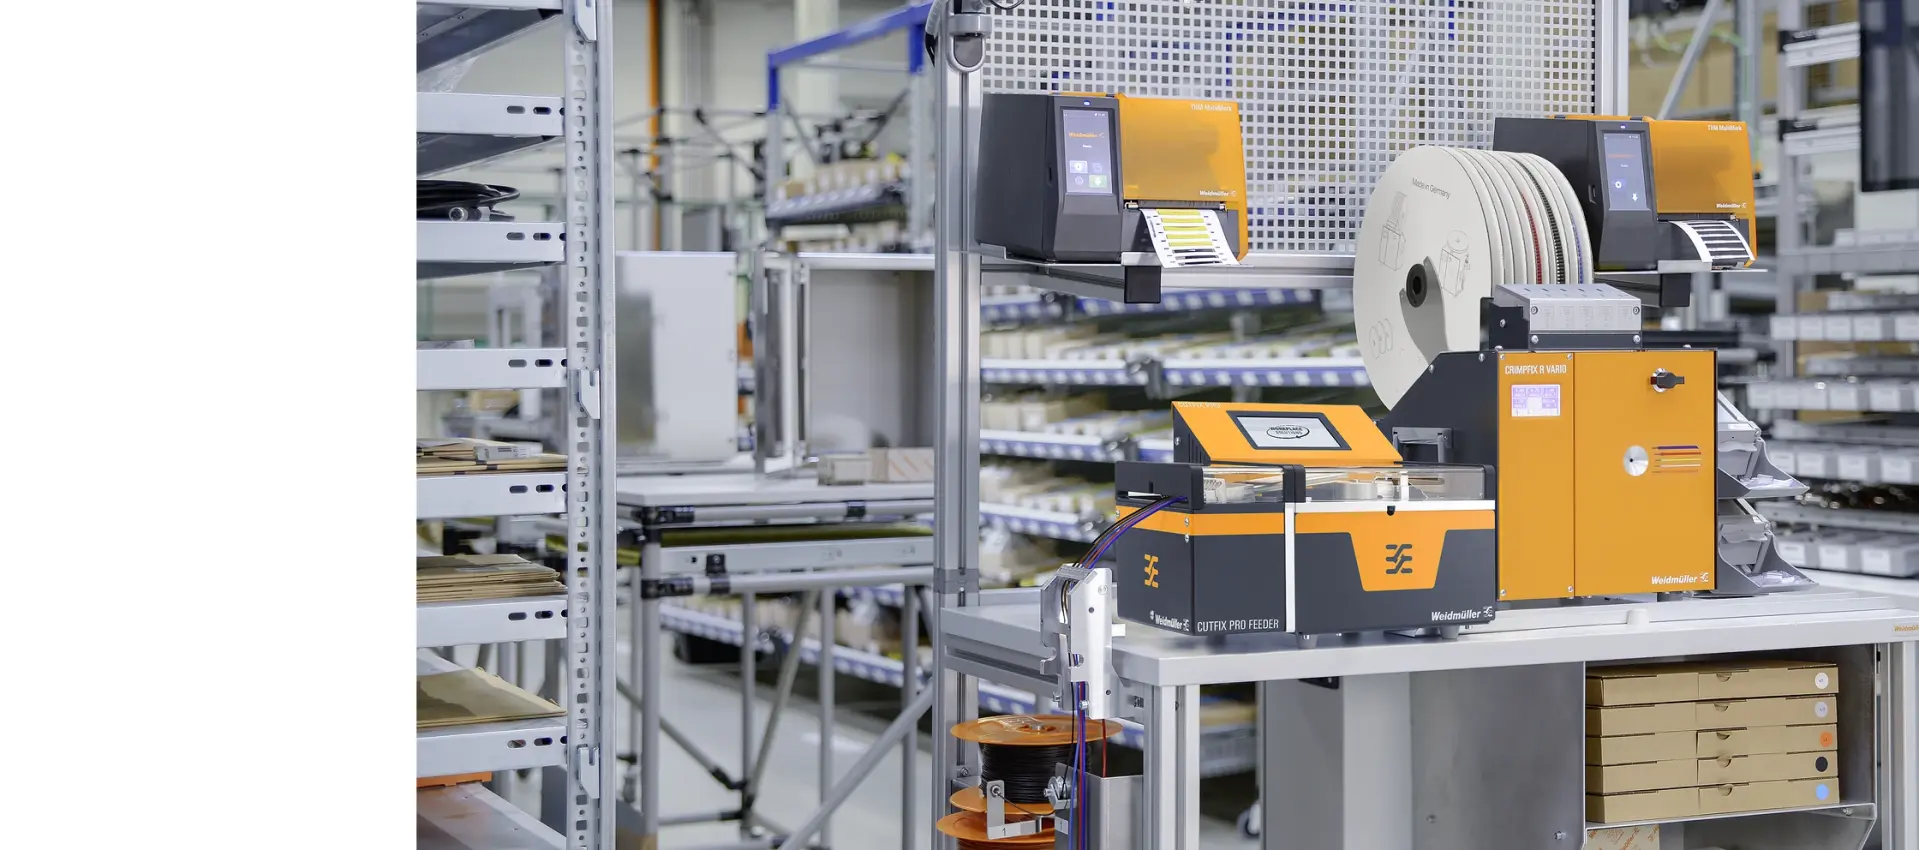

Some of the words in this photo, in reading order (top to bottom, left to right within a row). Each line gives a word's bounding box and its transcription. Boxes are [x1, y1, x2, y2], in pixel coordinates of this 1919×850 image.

[1412, 177, 1424, 189] Made
[1429, 184, 1451, 200] Germany
[1504, 365, 1538, 375] CRIMPFIX
[1539, 365, 1545, 374] R
[1545, 364, 1567, 374] VARIO
[1651, 575, 1698, 585] Weidmüller
[1431, 609, 1482, 621] Weidmüller
[1155, 613, 1183, 630] Weidmüller
[1197, 620, 1227, 632] CUTFIX
[1229, 619, 1247, 631] PRO
[1248, 618, 1280, 630] FEEDER
[1002, 827, 1007, 837] 1
